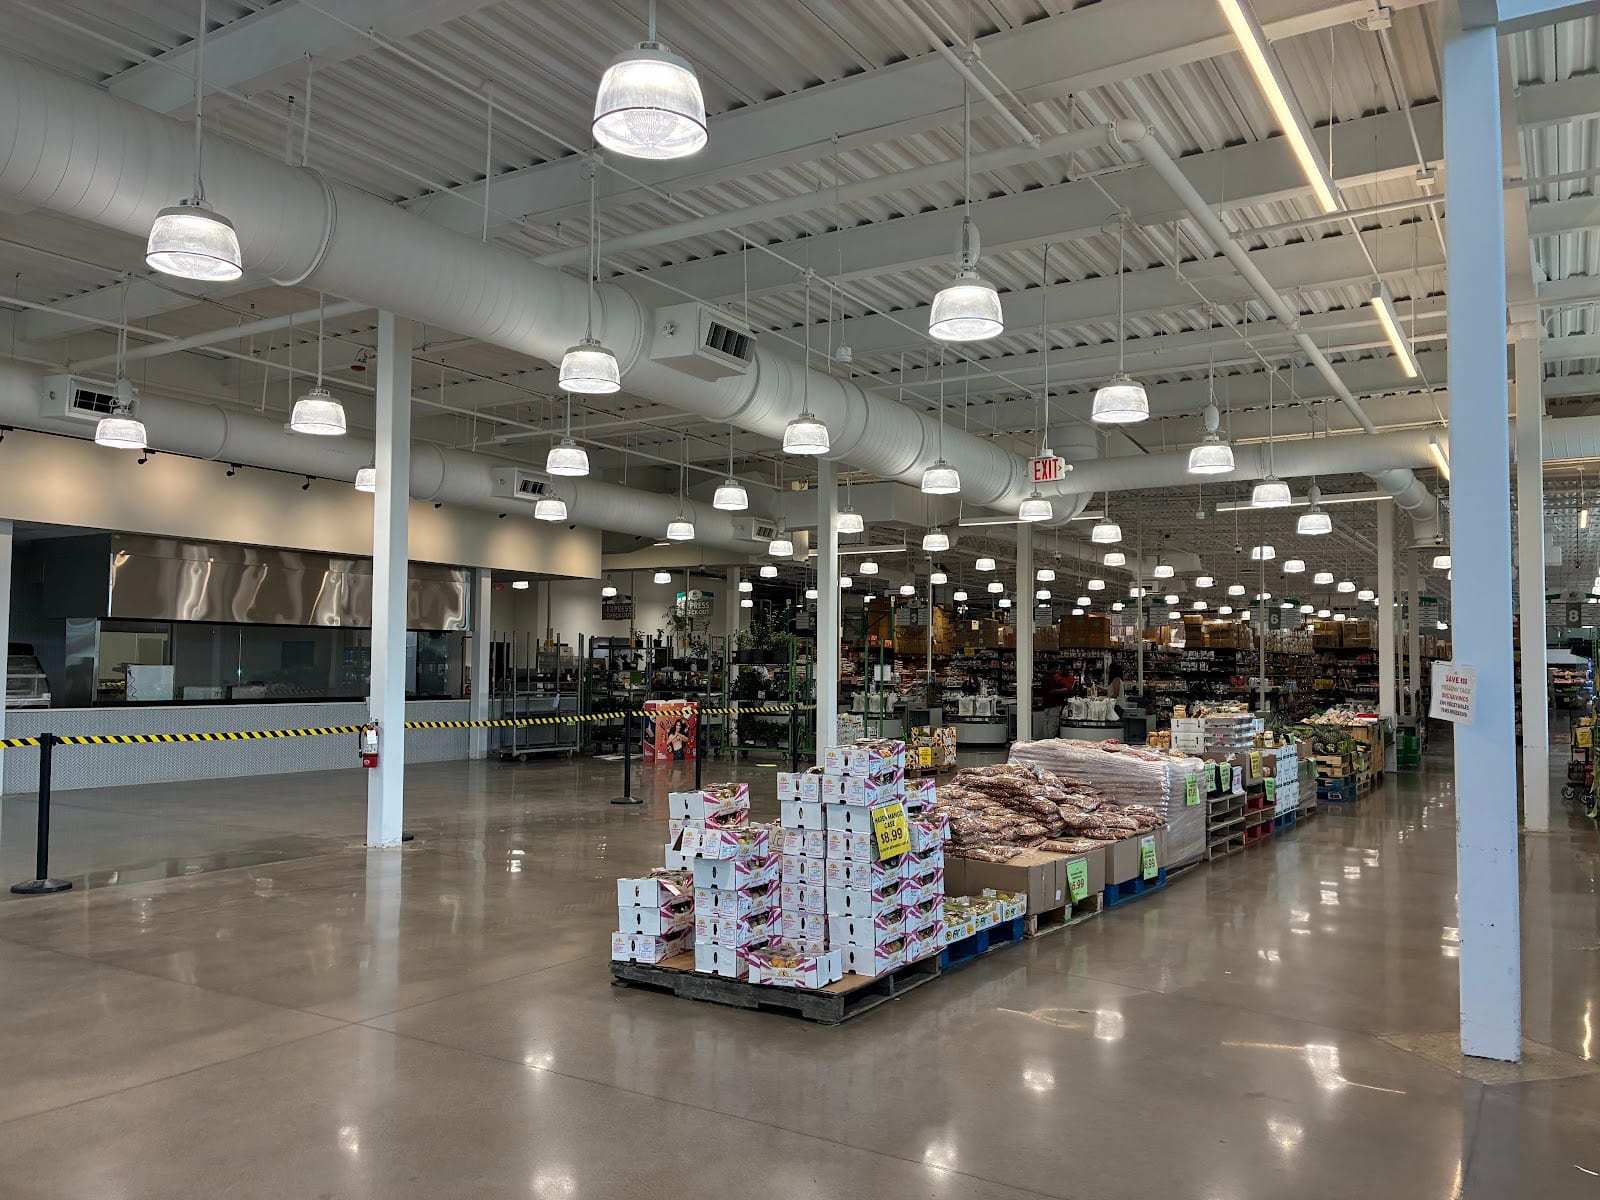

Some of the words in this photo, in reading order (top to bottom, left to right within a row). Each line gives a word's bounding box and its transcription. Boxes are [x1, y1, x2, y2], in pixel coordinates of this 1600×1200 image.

[1034, 459, 1058, 480] EXIT
[911, 613, 917, 623] 3
[1271, 613, 1279, 624] 6
[1569, 609, 1579, 622] 8
[809, 616, 815, 626] 2
[1446, 675, 1459, 683] SAVE
[1449, 693, 1469, 702] SAVINGS
[888, 810, 903, 819] MANGO
[880, 827, 903, 844] $8.99
